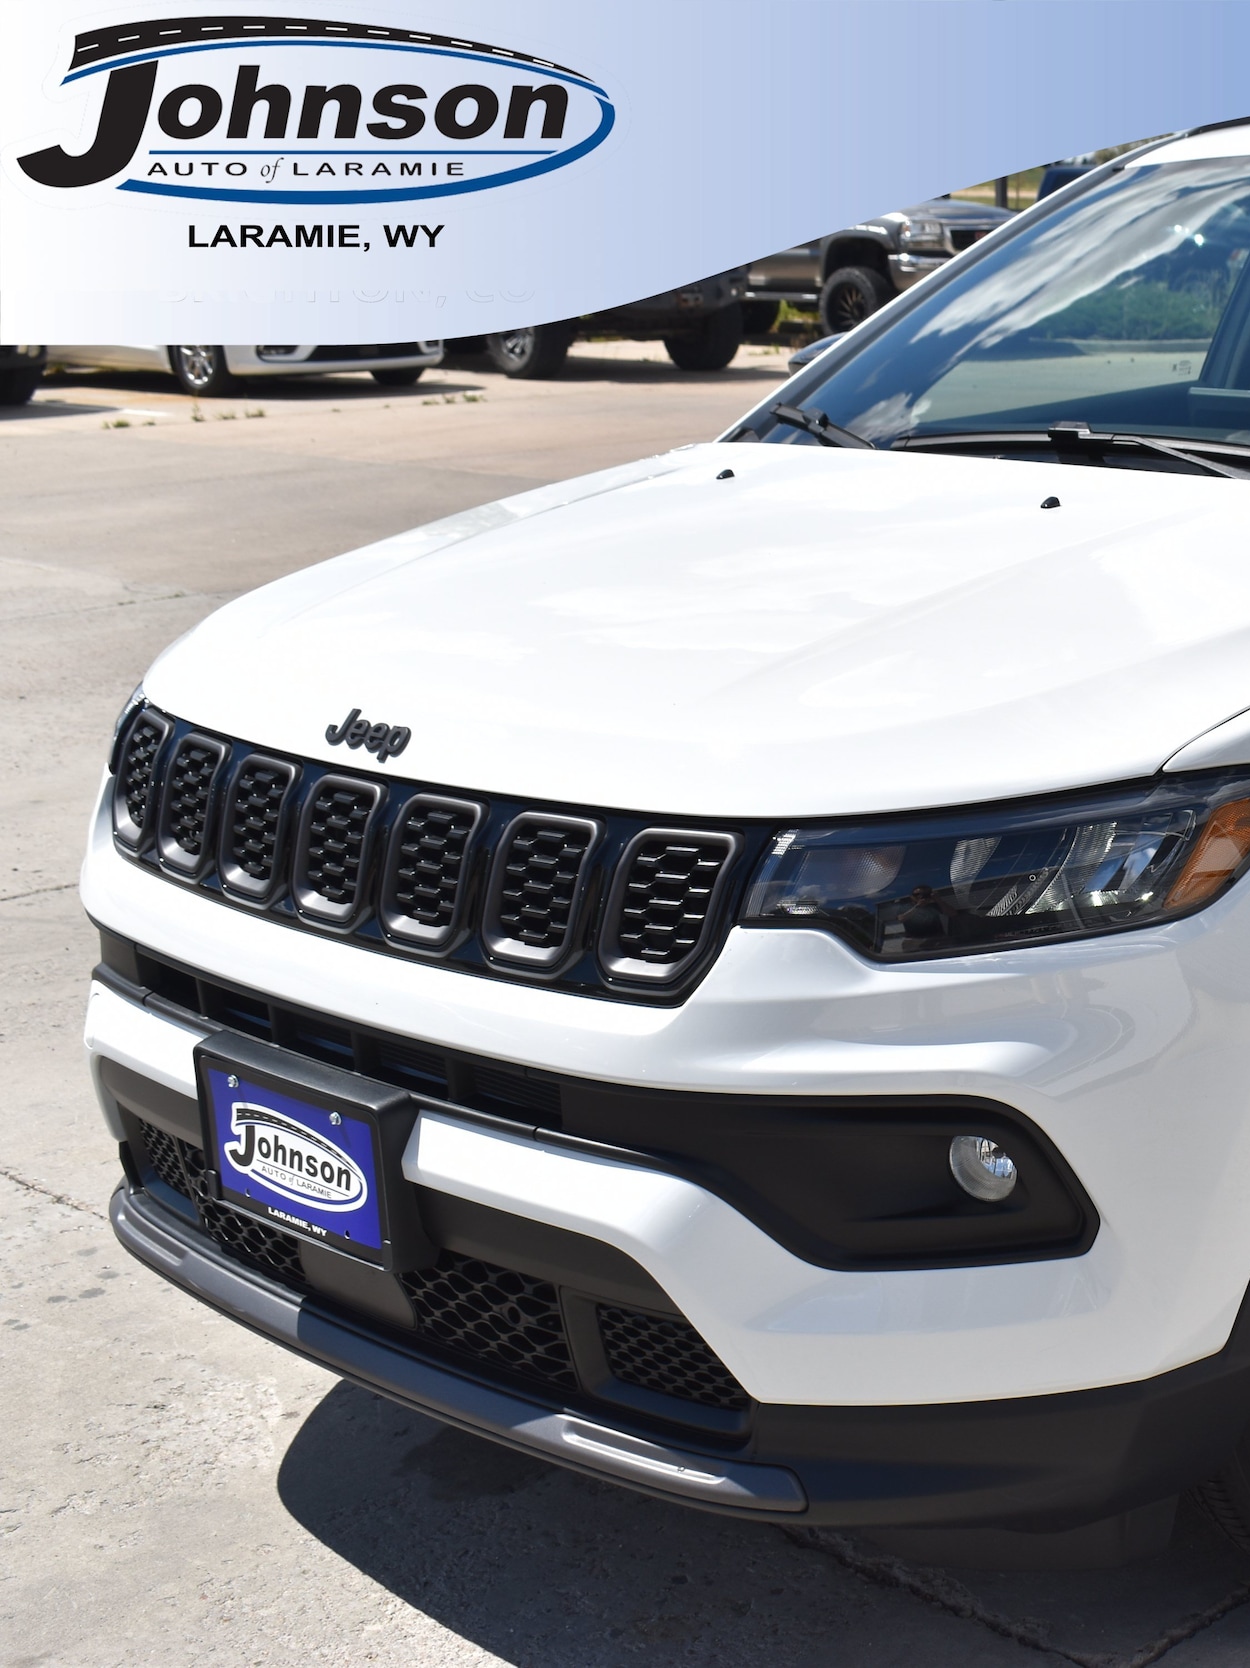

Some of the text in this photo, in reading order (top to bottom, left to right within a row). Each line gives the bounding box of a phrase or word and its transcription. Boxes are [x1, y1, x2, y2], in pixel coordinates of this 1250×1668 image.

[325, 708, 411, 764] Jeep
[229, 1125, 351, 1191] Johnson
[261, 1165, 287, 1181] AUTO
[296, 1179, 332, 1199] LARAMIE
[267, 1206, 328, 1237] LARAMIE, WY
